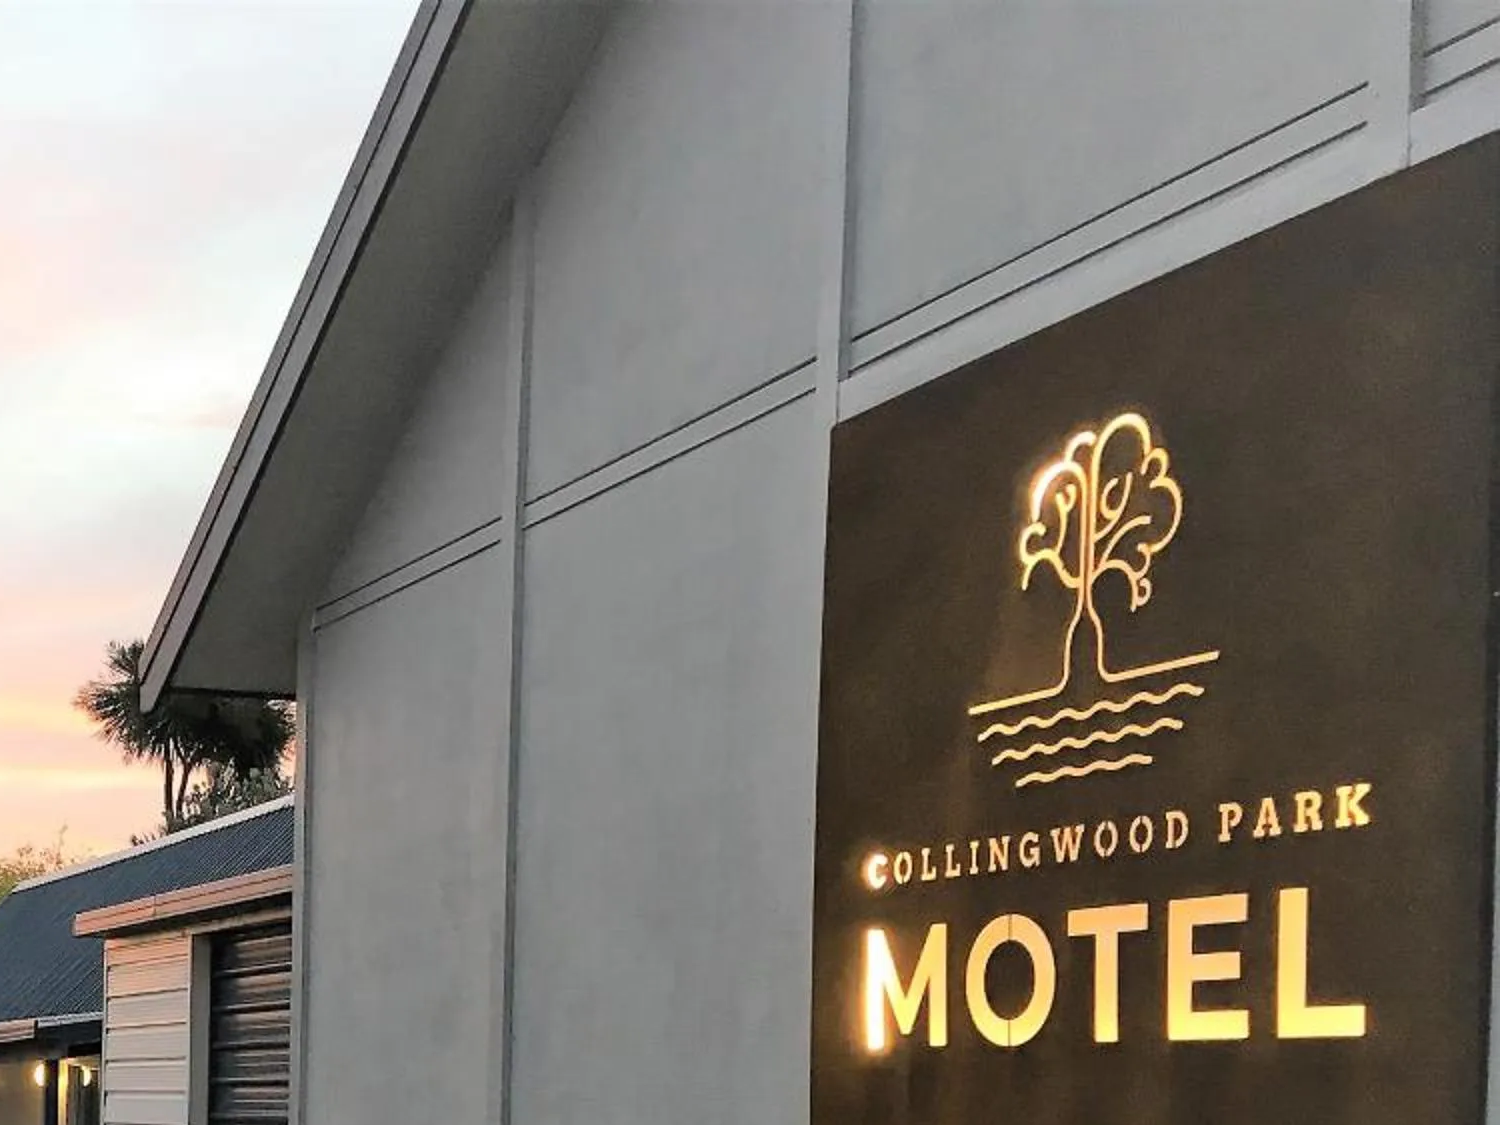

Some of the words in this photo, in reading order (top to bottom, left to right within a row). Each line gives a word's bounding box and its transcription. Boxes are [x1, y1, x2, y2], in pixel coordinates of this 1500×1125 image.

[865, 810, 1190, 889] COLLINGWOOD
[1218, 783, 1372, 843] PARK
[864, 887, 1366, 1050] MOTEL
